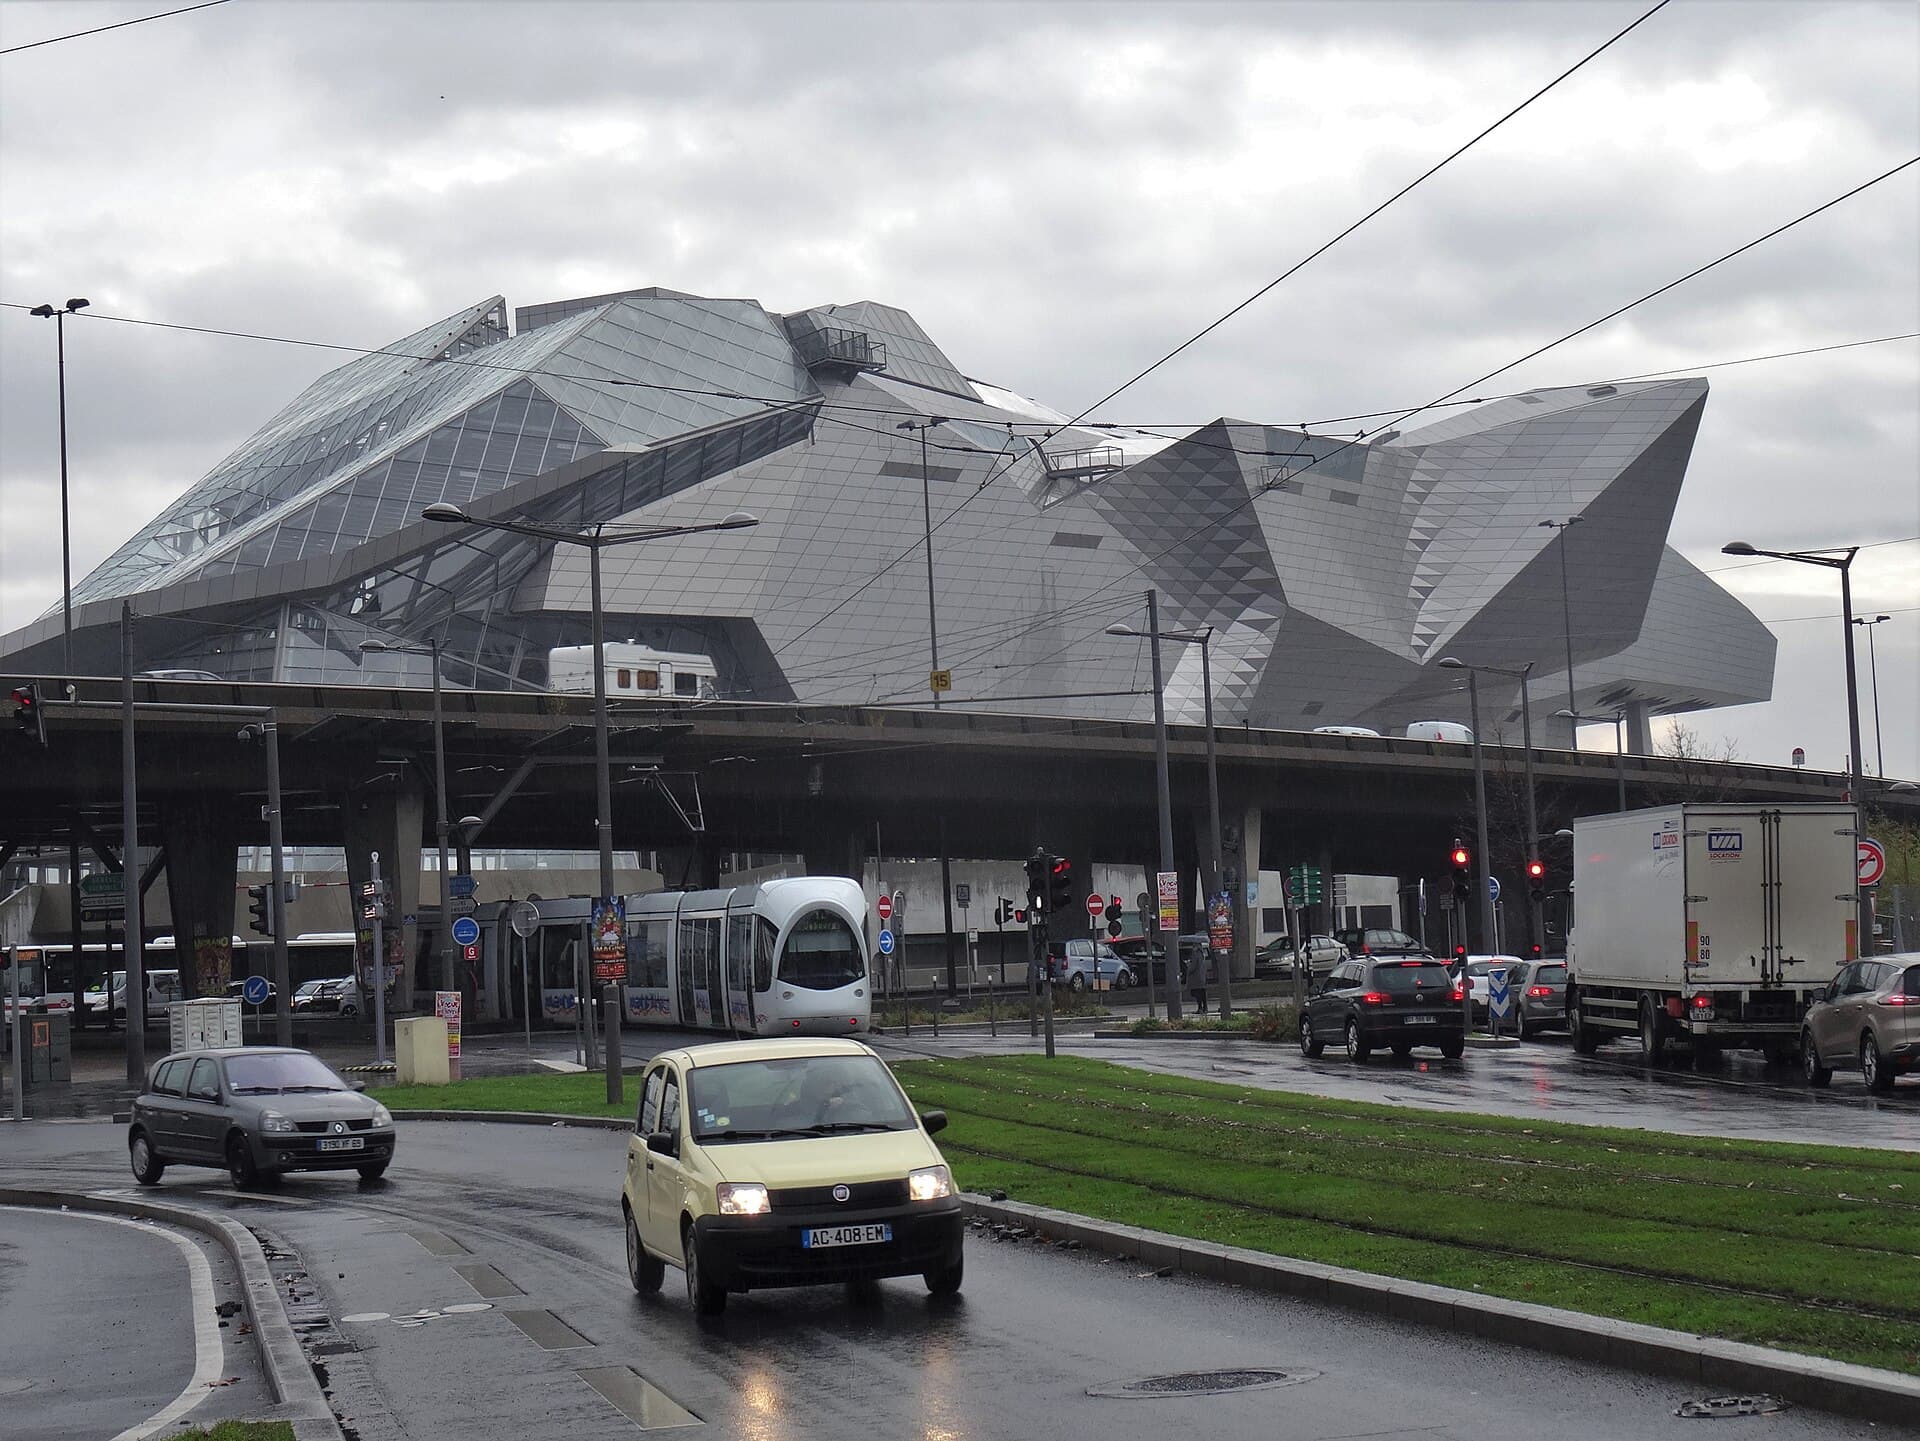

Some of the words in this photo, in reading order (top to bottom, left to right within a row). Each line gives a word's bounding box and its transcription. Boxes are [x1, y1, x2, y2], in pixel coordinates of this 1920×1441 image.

[934, 675, 948, 687] 15
[1711, 835, 1740, 848] VIA
[1700, 936, 1710, 946] 90
[468, 947, 475, 956] G
[1700, 949, 1710, 960] 80
